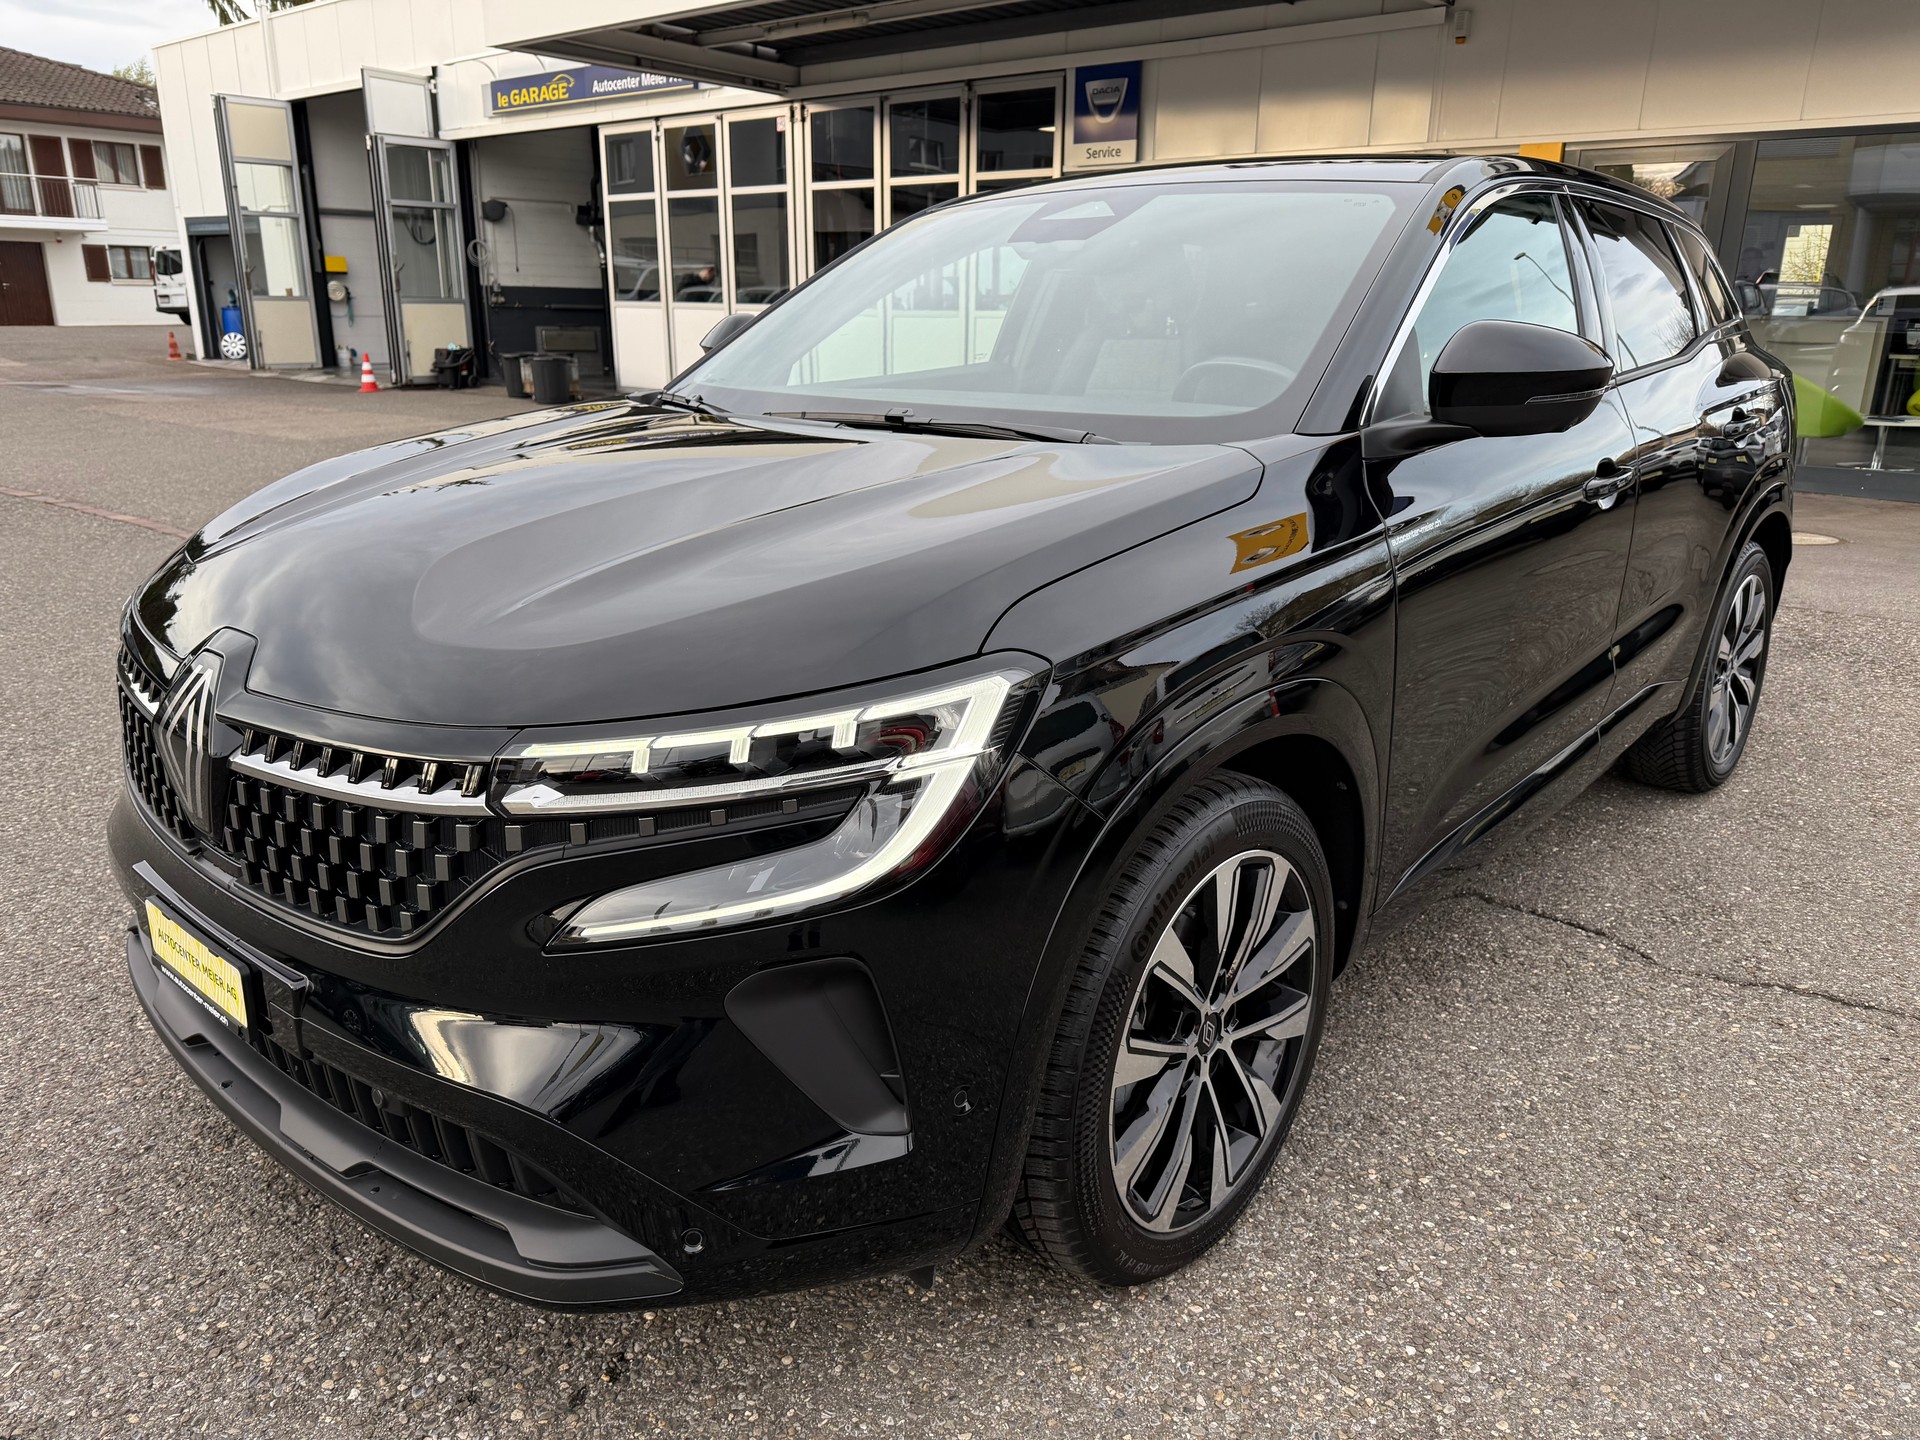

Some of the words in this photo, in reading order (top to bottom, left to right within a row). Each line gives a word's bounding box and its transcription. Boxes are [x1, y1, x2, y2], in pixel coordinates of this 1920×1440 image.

[497, 91, 509, 108] le
[510, 82, 569, 106] GARAGE
[592, 76, 641, 94] Autocenter
[1092, 86, 1120, 95] DACIA
[1086, 146, 1122, 160] Service
[158, 928, 201, 972] AUTOCENTER
[202, 964, 225, 990] MEIER
[226, 982, 237, 1000] AG
[160, 964, 229, 1027] www.autocenter-meier.ch
